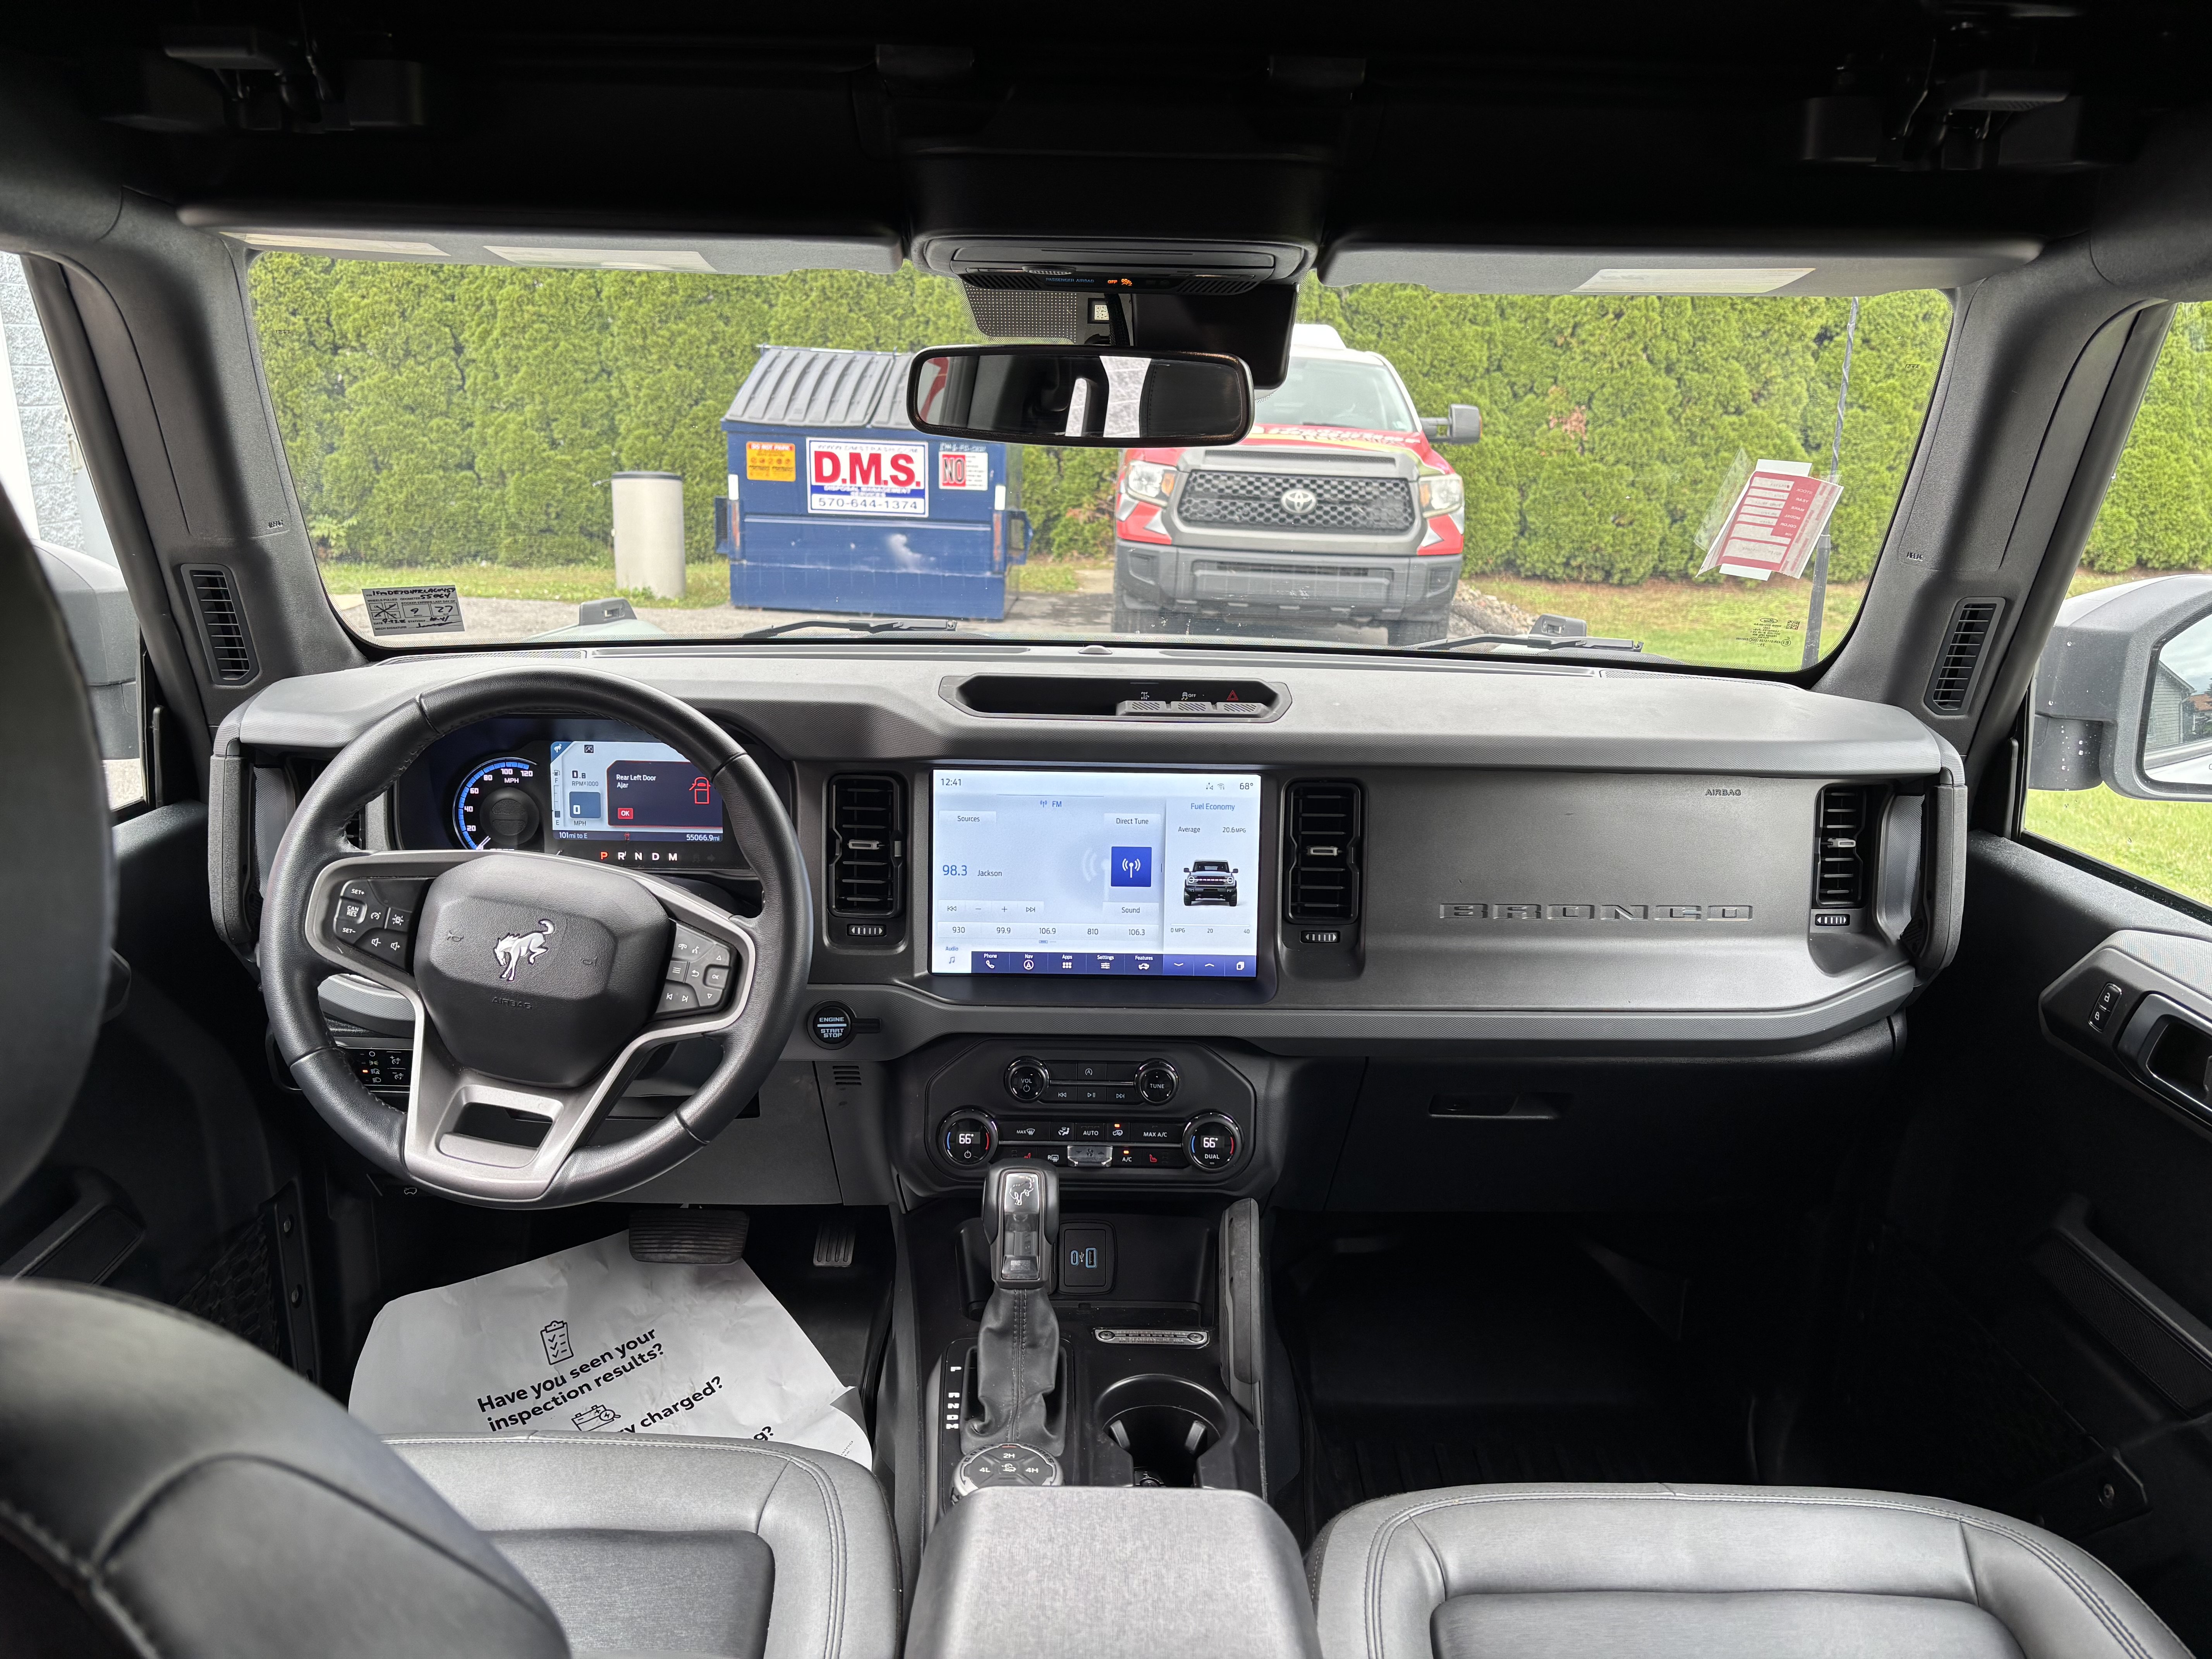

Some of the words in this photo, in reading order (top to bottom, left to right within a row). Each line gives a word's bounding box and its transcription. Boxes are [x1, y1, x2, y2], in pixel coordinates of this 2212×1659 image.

[814, 451, 921, 487] D.M.S.
[942, 457, 965, 484] NO
[819, 498, 917, 509] 570-644-1374
[1705, 789, 1742, 797] AIRBAG
[573, 805, 580, 814] 0
[600, 852, 608, 860] P
[942, 865, 967, 876] 98.3
[1121, 906, 1140, 914] Sound
[1439, 903, 1753, 921] BRONCO
[492, 997, 532, 1009] AIRBAG
[477, 1389, 528, 1413] Have
[530, 1374, 567, 1399] you
[570, 1350, 614, 1379] seen
[615, 1329, 656, 1359] your
[487, 1383, 592, 1432] inspection
[594, 1343, 665, 1388] results?
[641, 1376, 723, 1427] charged?
[1024, 1444, 1054, 1463] MODES
